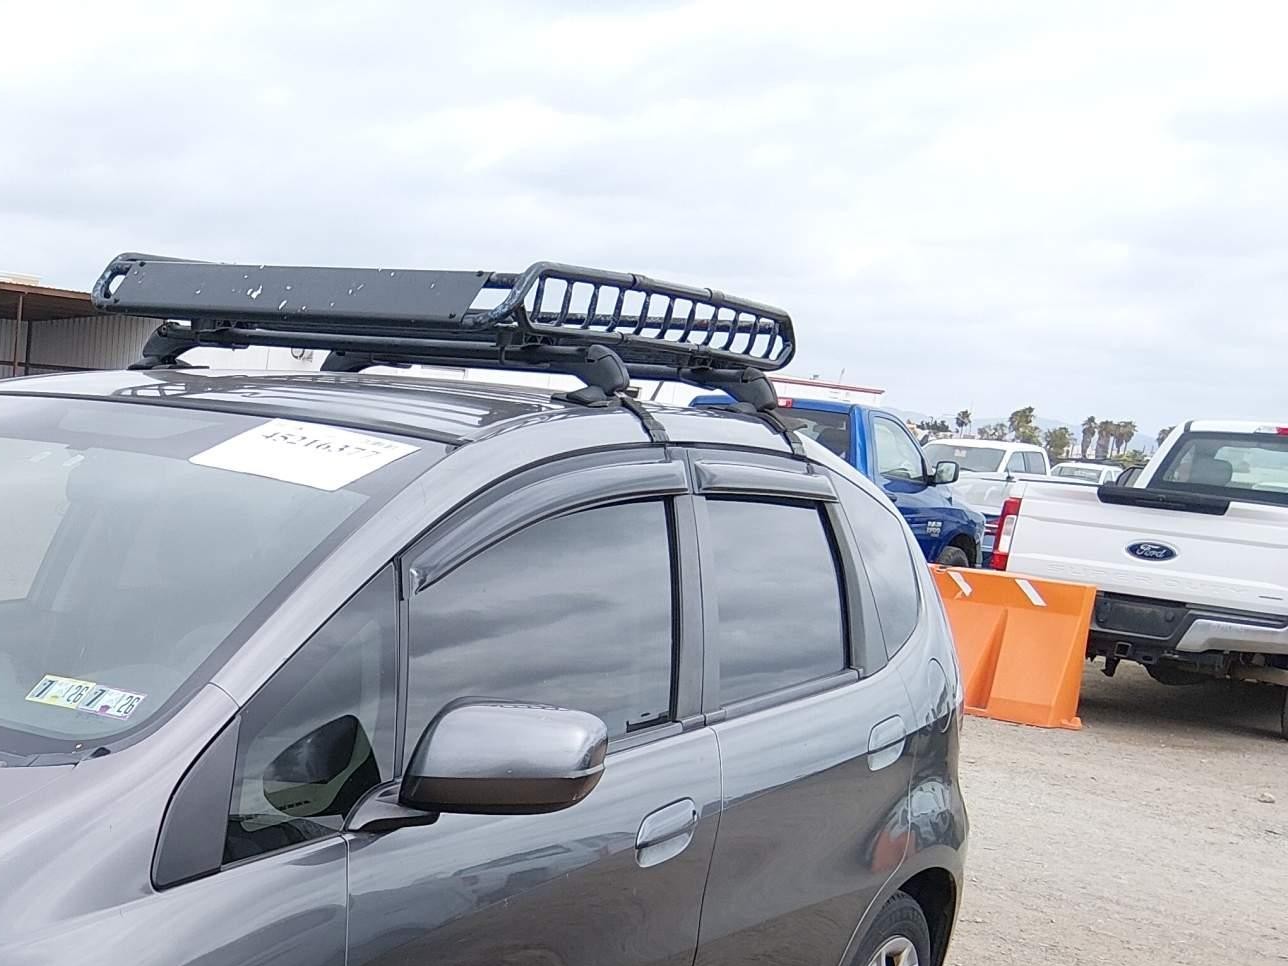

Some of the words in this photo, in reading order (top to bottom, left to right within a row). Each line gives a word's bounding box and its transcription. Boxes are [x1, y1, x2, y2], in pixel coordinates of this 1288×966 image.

[1135, 543, 1168, 558] Ford
[86, 688, 107, 707] 7
[116, 695, 141, 715] 26
